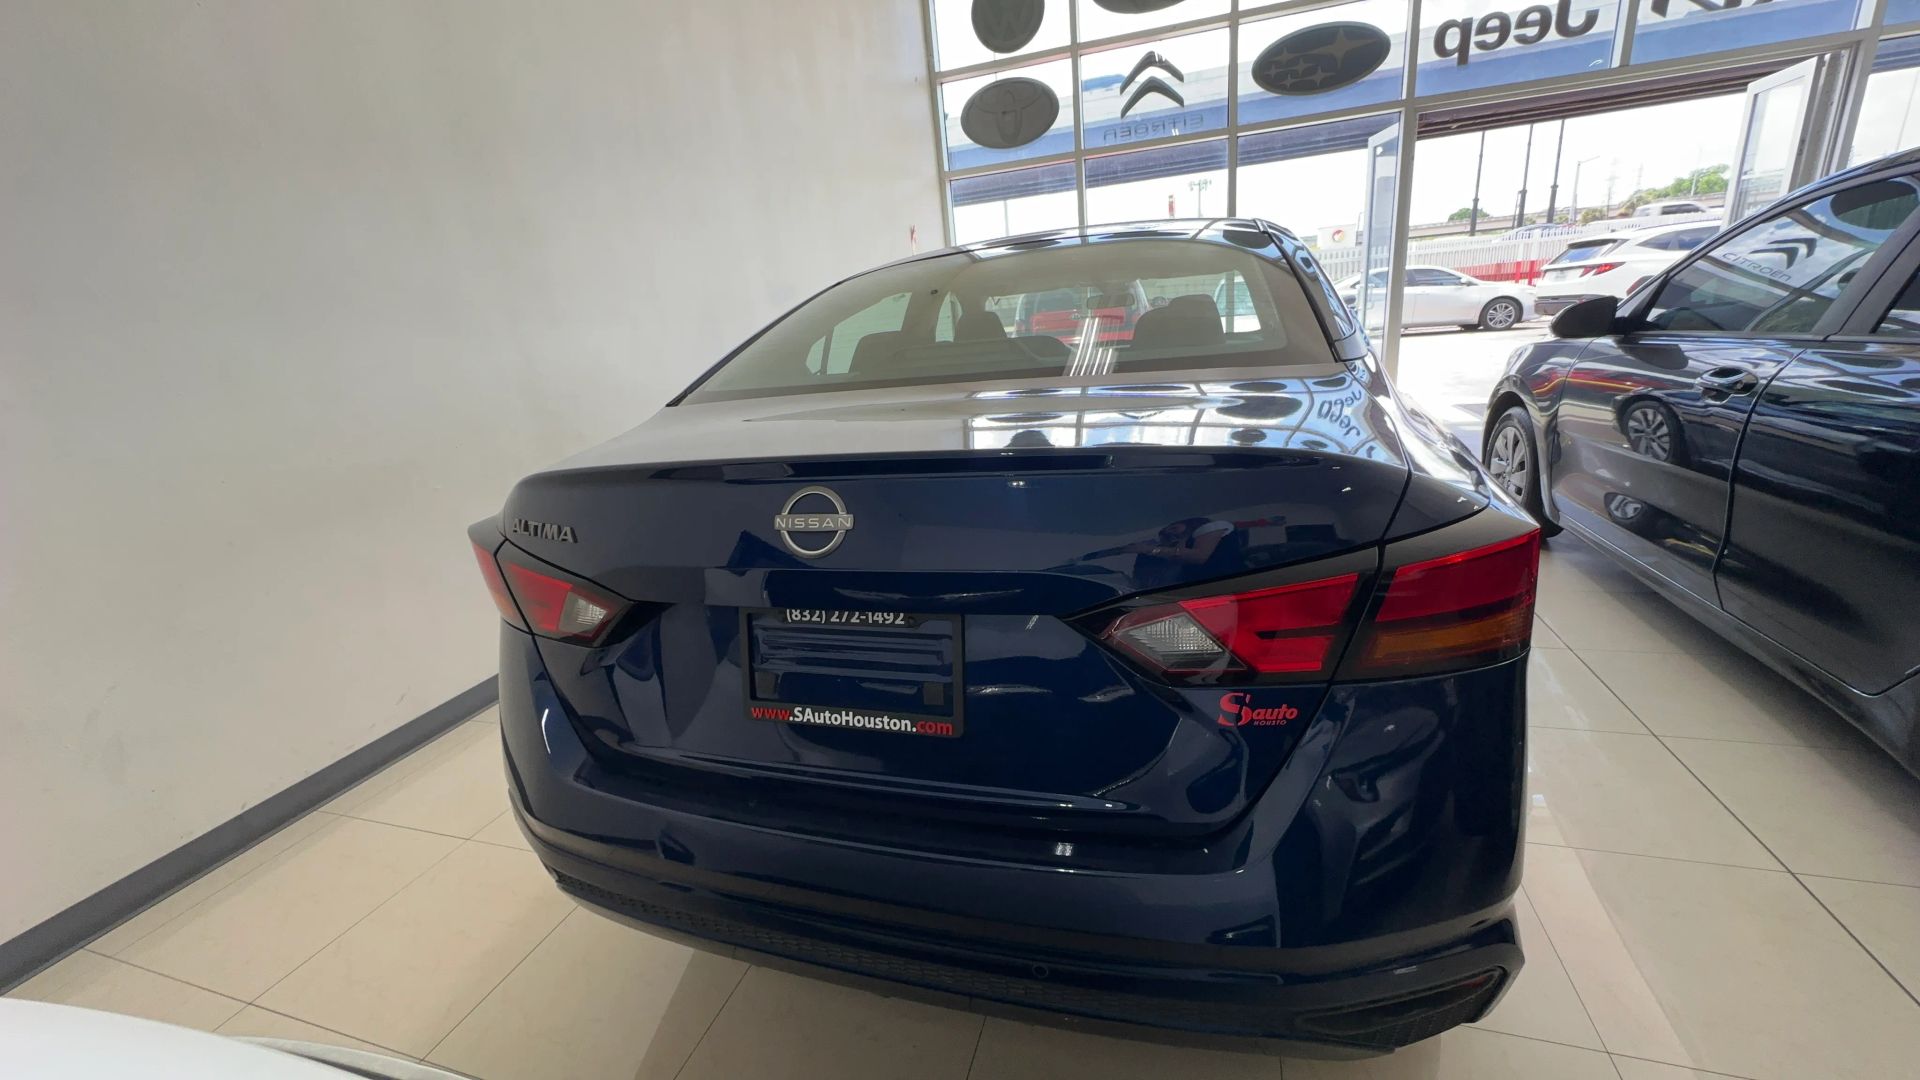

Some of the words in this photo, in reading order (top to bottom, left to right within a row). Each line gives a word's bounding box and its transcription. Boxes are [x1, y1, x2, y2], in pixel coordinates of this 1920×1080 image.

[512, 518, 577, 543] ALTIMA
[776, 517, 851, 528] NISSAN
[751, 706, 953, 735] www.SAutoHouston.com
